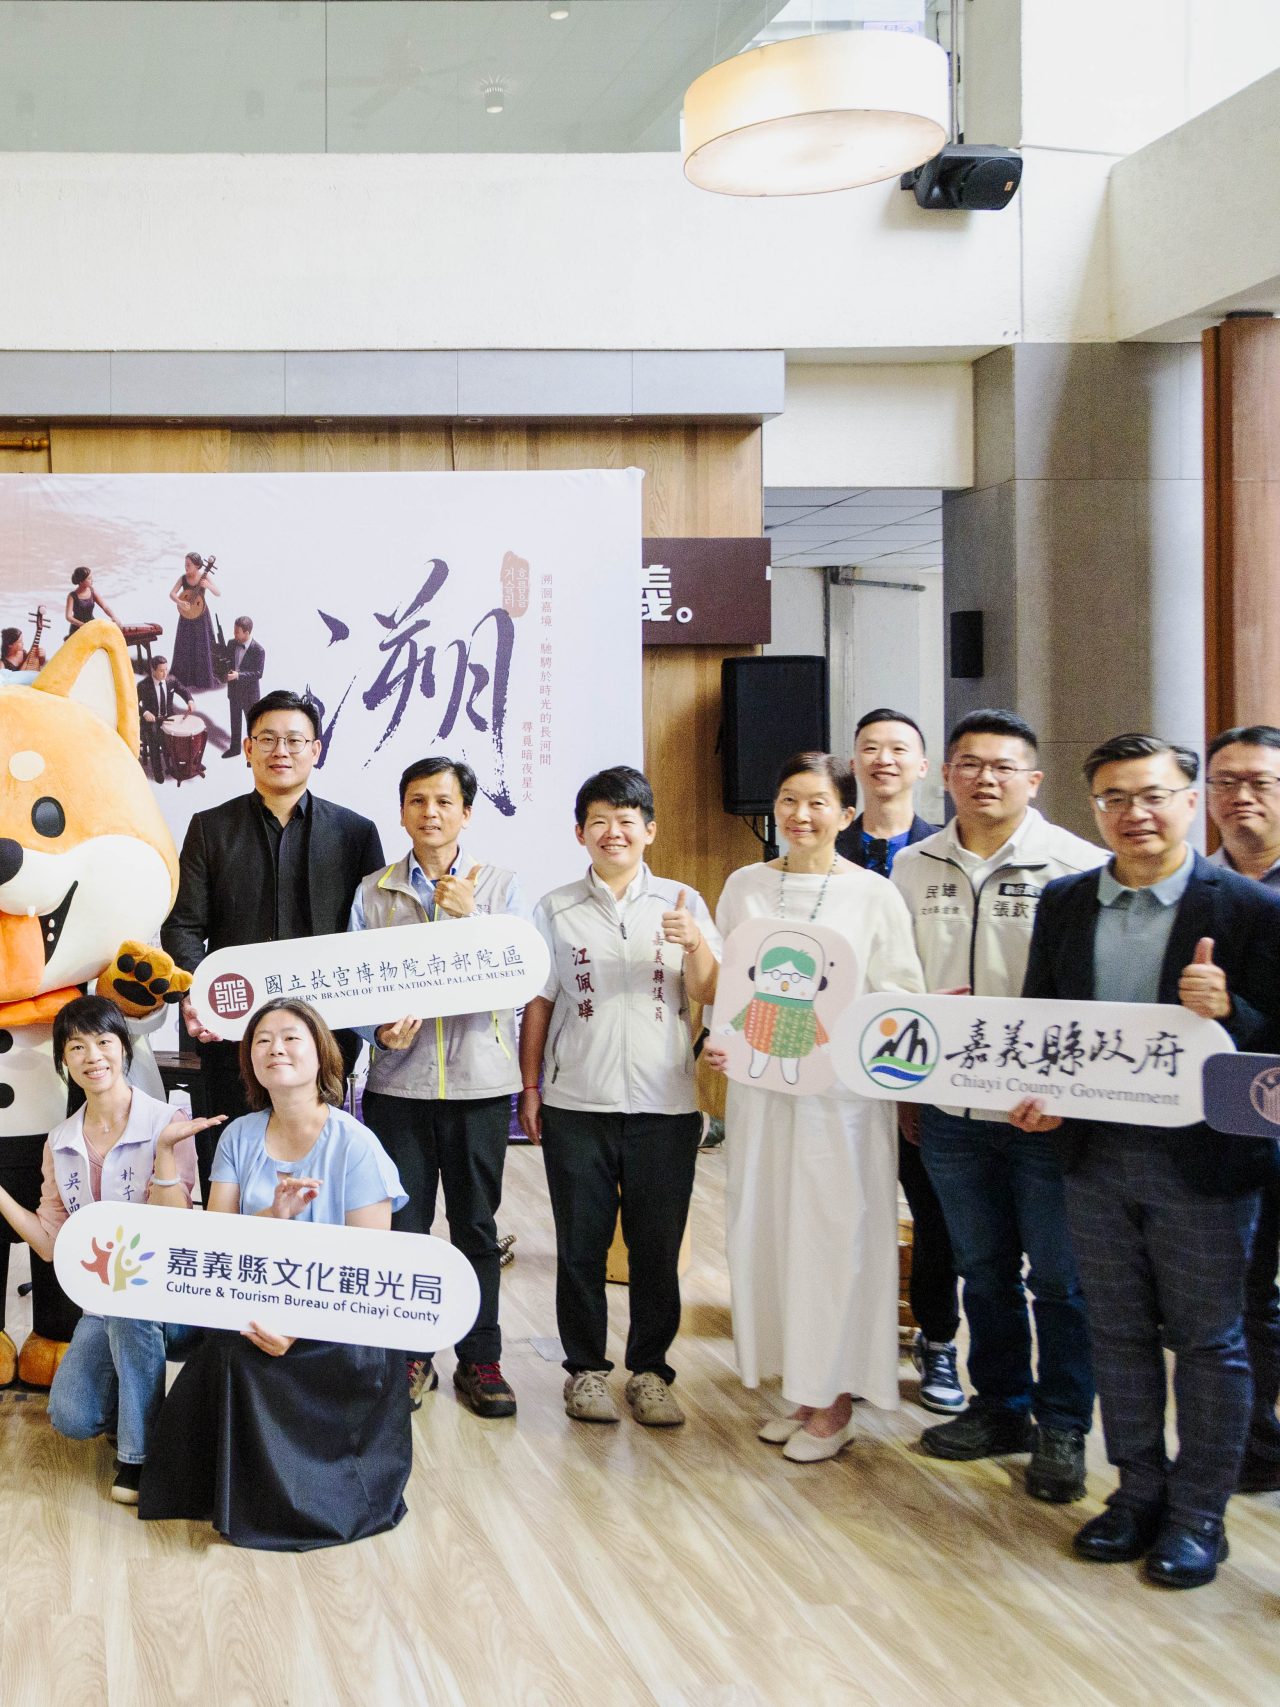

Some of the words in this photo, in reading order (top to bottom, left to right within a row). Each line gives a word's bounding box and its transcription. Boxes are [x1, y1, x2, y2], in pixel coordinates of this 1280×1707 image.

[516, 567, 528, 608] 흐름을
[521, 721, 534, 802] 尋覓暗夜星火
[265, 945, 524, 994] 國立故宮博物院南部院區
[321, 989, 359, 1000] BRANCH
[361, 987, 373, 995] OF
[377, 983, 395, 993] THE
[397, 978, 444, 991] NATIONAL
[447, 973, 483, 985] PALACE
[485, 968, 526, 979] MUSEUM
[945, 1018, 1184, 1077] 嘉義縣政府
[950, 1073, 1001, 1093] Chiayi
[1006, 1077, 1065, 1100] County
[1070, 1082, 1180, 1106] Government
[167, 1248, 442, 1304] 嘉義縣文化觀光局
[166, 1281, 212, 1297] Culture
[216, 1286, 225, 1298] &
[229, 1288, 280, 1304] Tourism
[284, 1295, 329, 1310] Bureau
[333, 1299, 346, 1311] of
[350, 1301, 389, 1318] Chiayi
[393, 1306, 440, 1325] County
